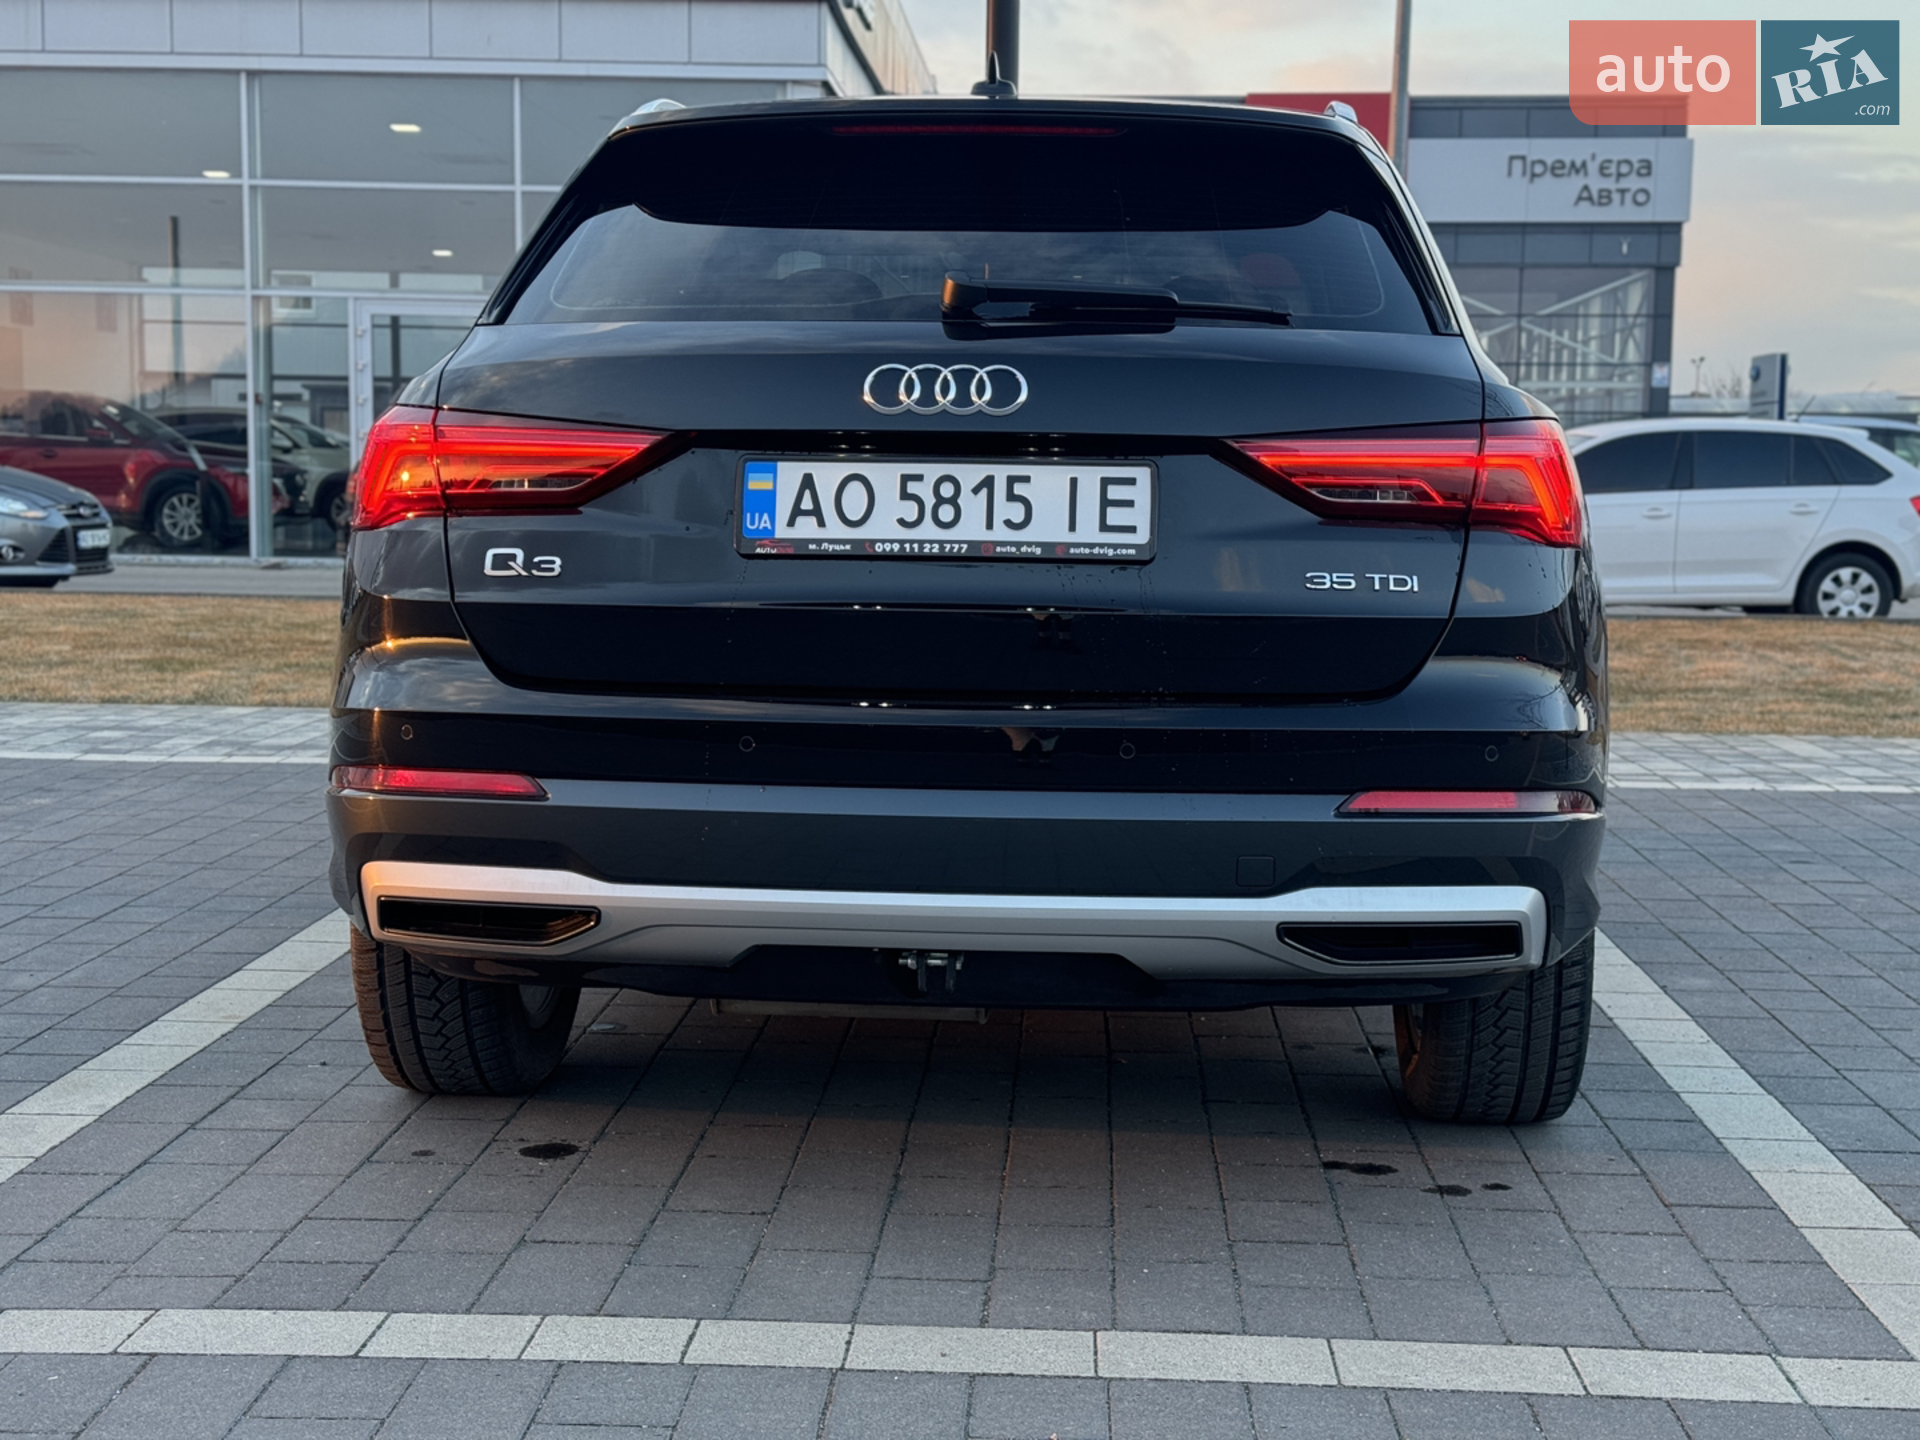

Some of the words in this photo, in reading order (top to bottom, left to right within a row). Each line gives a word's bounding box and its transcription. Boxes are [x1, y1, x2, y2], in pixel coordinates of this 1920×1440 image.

[1507, 152, 1653, 184] Прем'єра
[1573, 183, 1651, 207] Авто
[786, 472, 876, 529] AO
[896, 473, 1033, 531] 5815
[1068, 475, 1138, 534] IE
[747, 512, 772, 530] UA
[874, 542, 900, 553] 099
[903, 542, 919, 553] 11
[922, 543, 940, 553] 22
[943, 543, 969, 554] 777
[483, 547, 562, 577] Q3
[1304, 572, 1357, 590] 35
[1364, 573, 1420, 592] TDI
